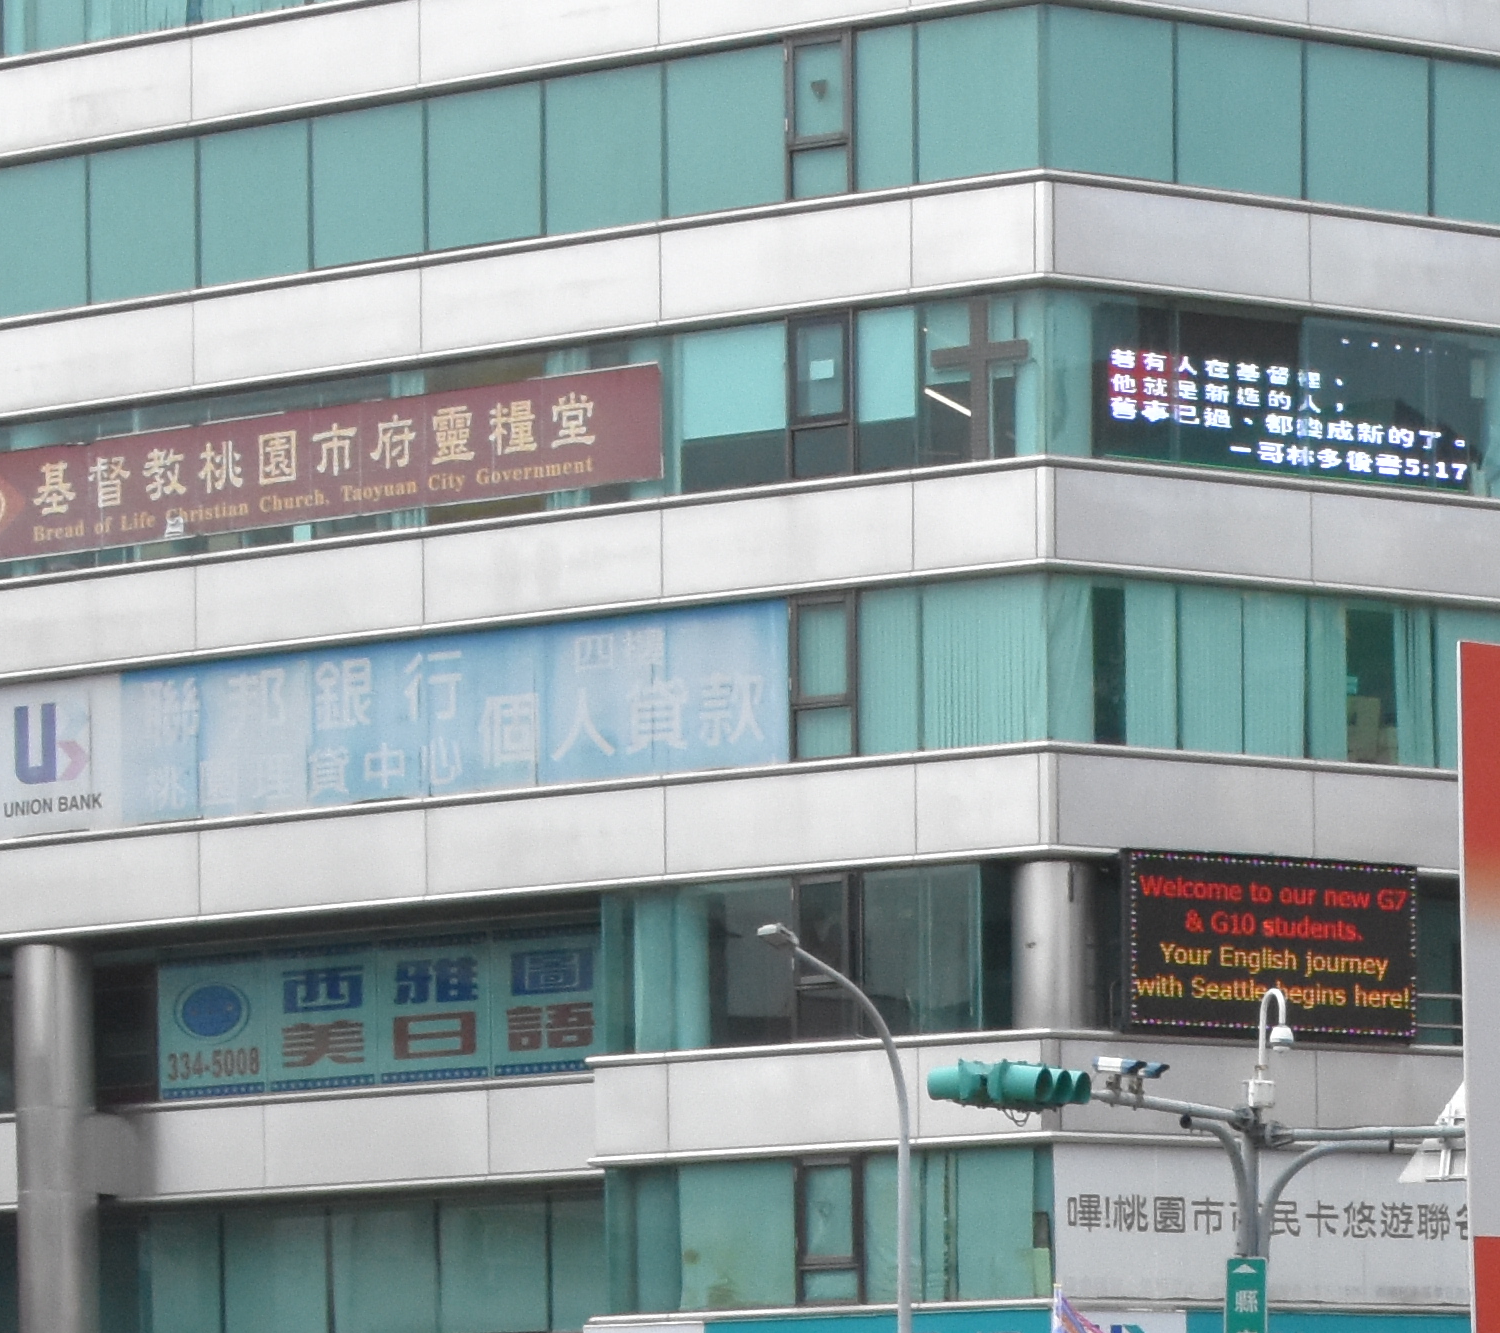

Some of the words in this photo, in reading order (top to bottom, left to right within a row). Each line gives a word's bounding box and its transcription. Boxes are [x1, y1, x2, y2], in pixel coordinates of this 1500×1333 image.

[33, 391, 596, 516] 基督教桃園市府靈糧堂
[33, 521, 85, 543] Bread
[94, 513, 112, 536] of
[120, 511, 156, 533] Life
[165, 500, 249, 529] Christian
[340, 479, 418, 504] Taoyuan
[428, 472, 466, 494] City
[475, 456, 594, 487] Government
[138, 649, 464, 747] 聯邦銀行
[478, 672, 765, 770] 個人貸款
[3, 799, 54, 820] UNION
[57, 792, 103, 814] BANK
[1140, 874, 1242, 902] Welcome
[1249, 880, 1272, 902] to
[1280, 886, 1316, 905] our
[1324, 889, 1370, 909] new
[1377, 888, 1408, 911] G7
[1185, 910, 1203, 931] &
[1211, 911, 1256, 935] G10
[1263, 917, 1364, 942] students.
[282, 946, 594, 1015] 西雅圖
[1161, 942, 1211, 967] Your
[1220, 946, 1297, 975] English
[1305, 951, 1389, 981] journey
[1136, 977, 1183, 999] with
[1192, 977, 1267, 1003] Seattle
[1355, 984, 1411, 1010] here!
[282, 1002, 596, 1068] 美日語
[167, 1046, 261, 1082] 334-5008
[1067, 1192, 1468, 1242] 嗶!桃園市民卡悠遊聯
